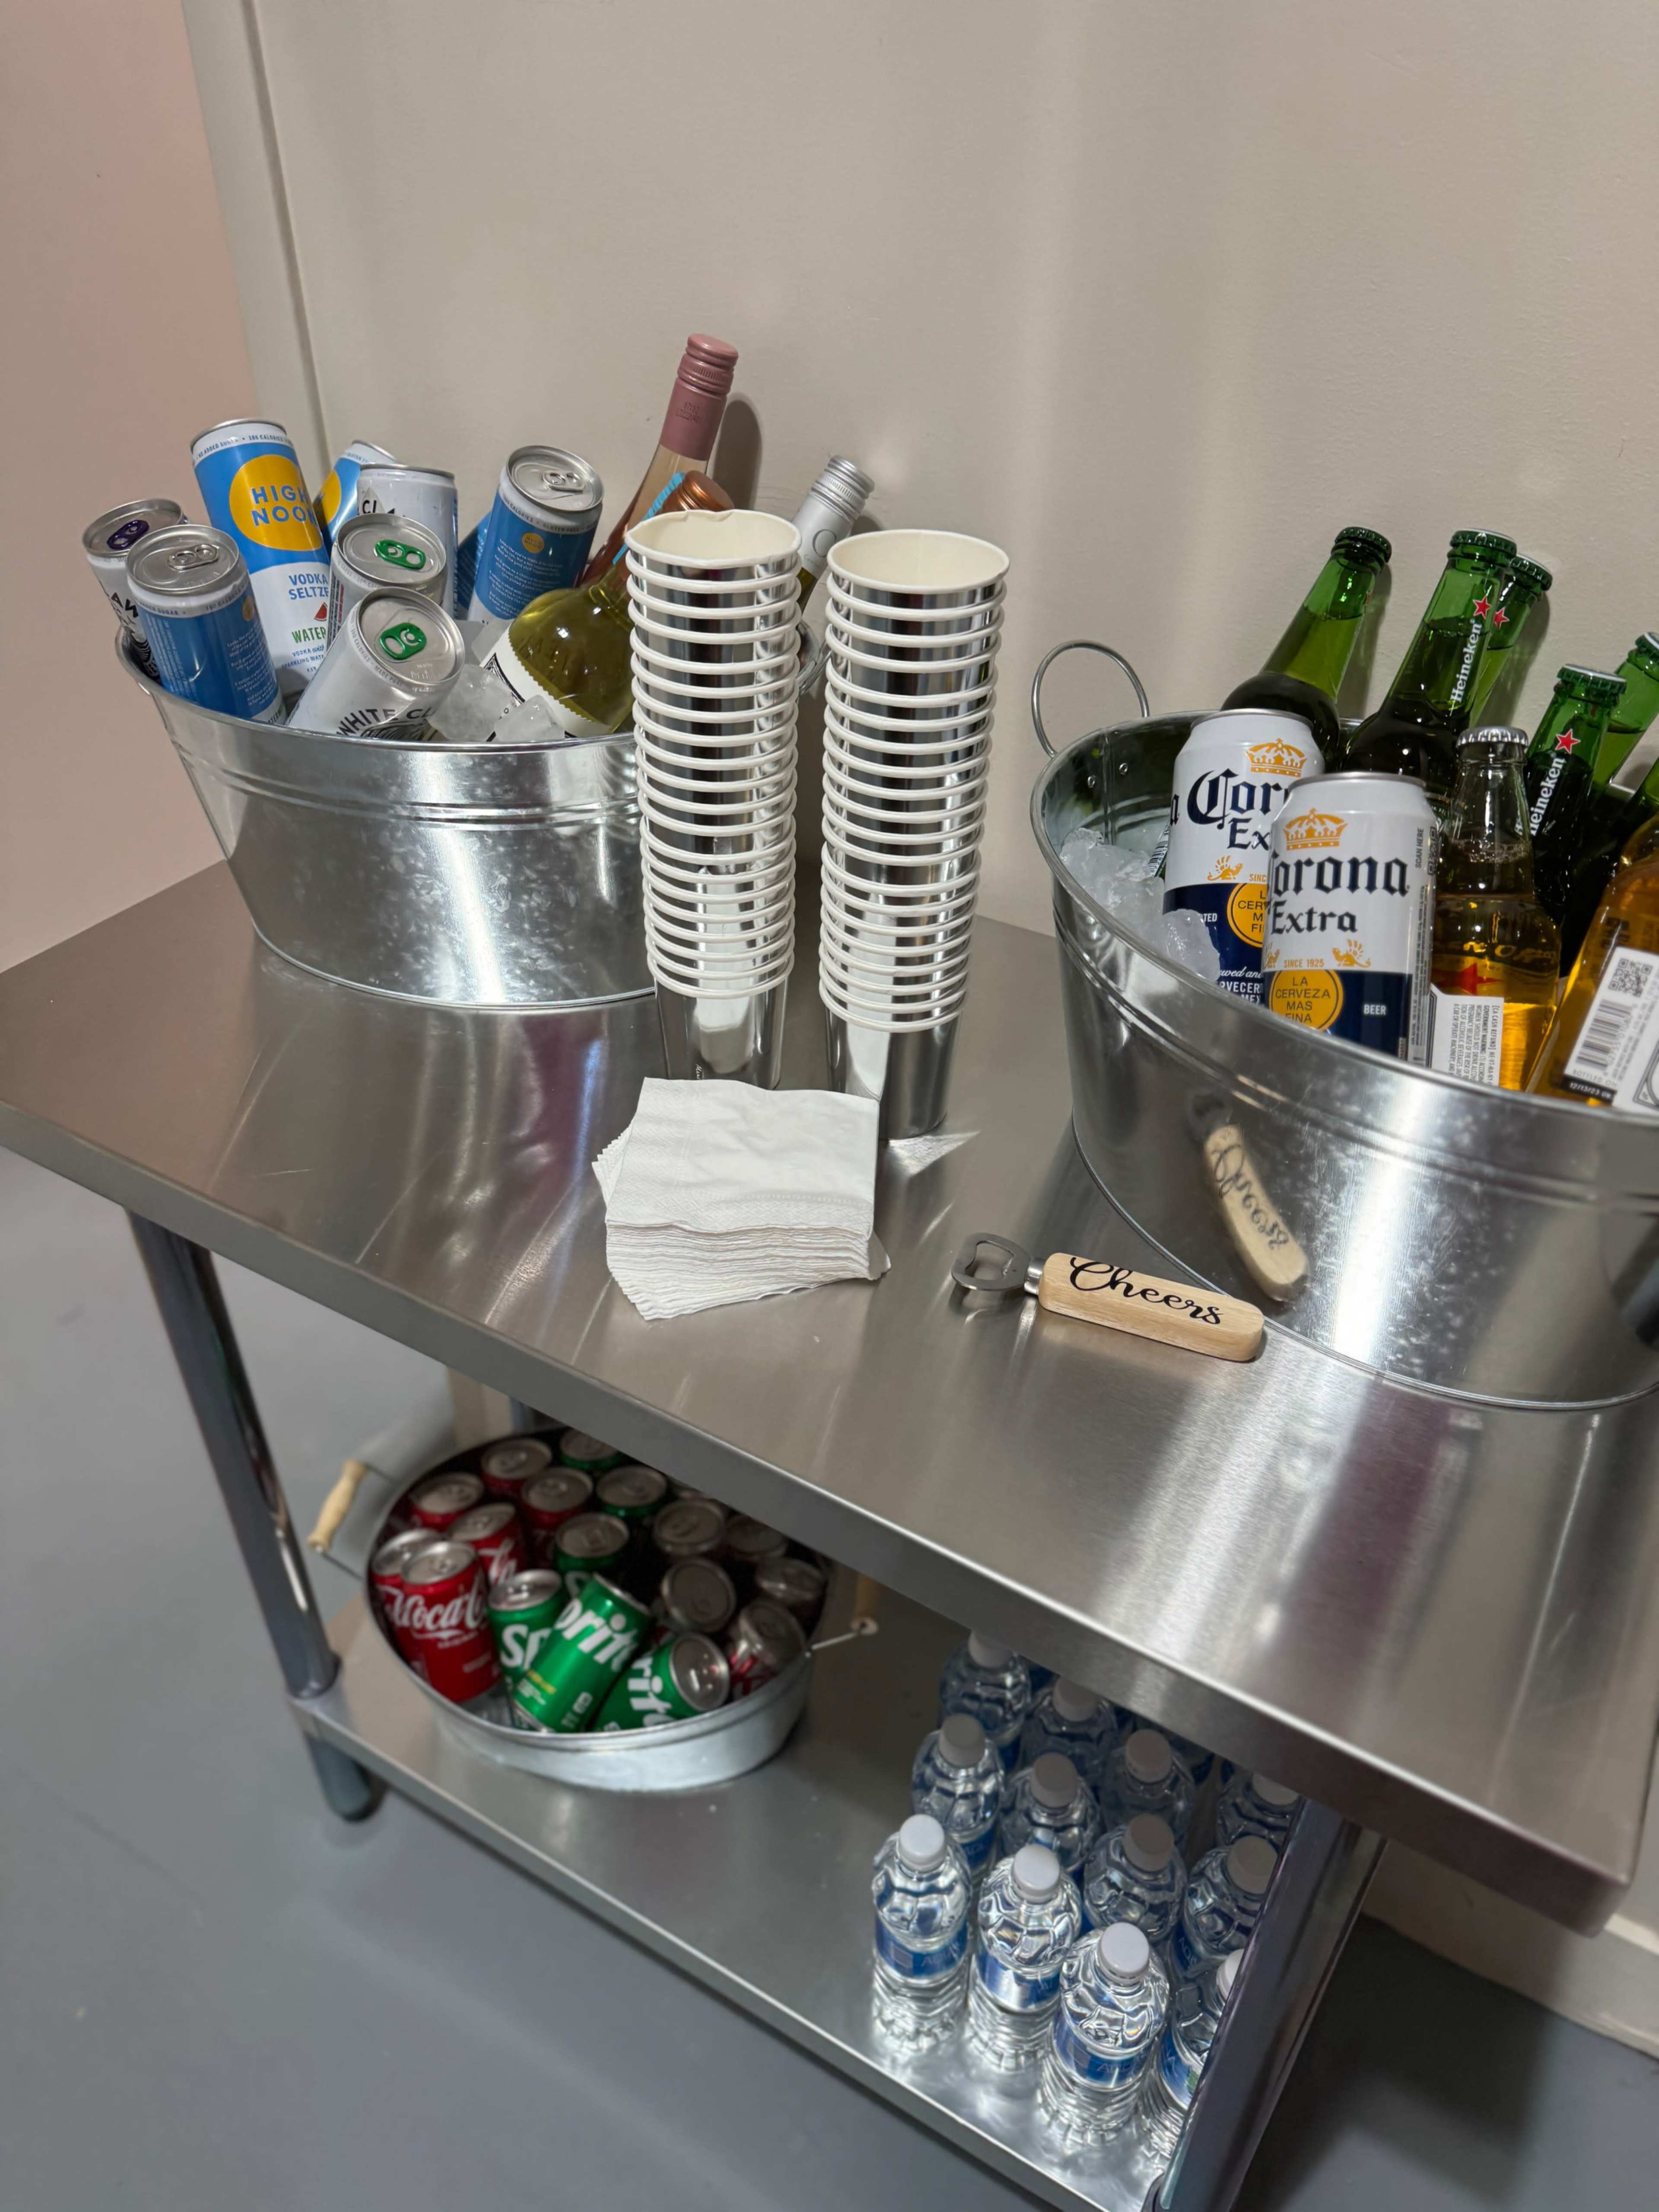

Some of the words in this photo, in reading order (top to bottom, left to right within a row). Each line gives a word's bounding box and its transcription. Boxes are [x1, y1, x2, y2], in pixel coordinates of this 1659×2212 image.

[204, 443, 219, 454] ADDED
[289, 573, 328, 586] VODKA
[289, 586, 329, 600] SELTZE
[292, 627, 326, 643] WATER
[292, 649, 311, 657] VODKA
[1450, 623, 1482, 703] Heineken
[375, 665, 388, 678] MADE
[337, 709, 398, 736] WHITE
[1249, 874, 1266, 882] SINC
[1272, 850, 1408, 897] orona
[1271, 900, 1358, 935] Extra
[1283, 959, 1302, 968] SINCE
[1306, 958, 1324, 968] 1925
[1292, 977, 1309, 987] LA
[1275, 989, 1331, 999] CERVEZA
[1286, 1000, 1313, 1011] MAS
[1363, 1004, 1386, 1015] BEER
[1069, 1257, 1224, 1325] Cheers
